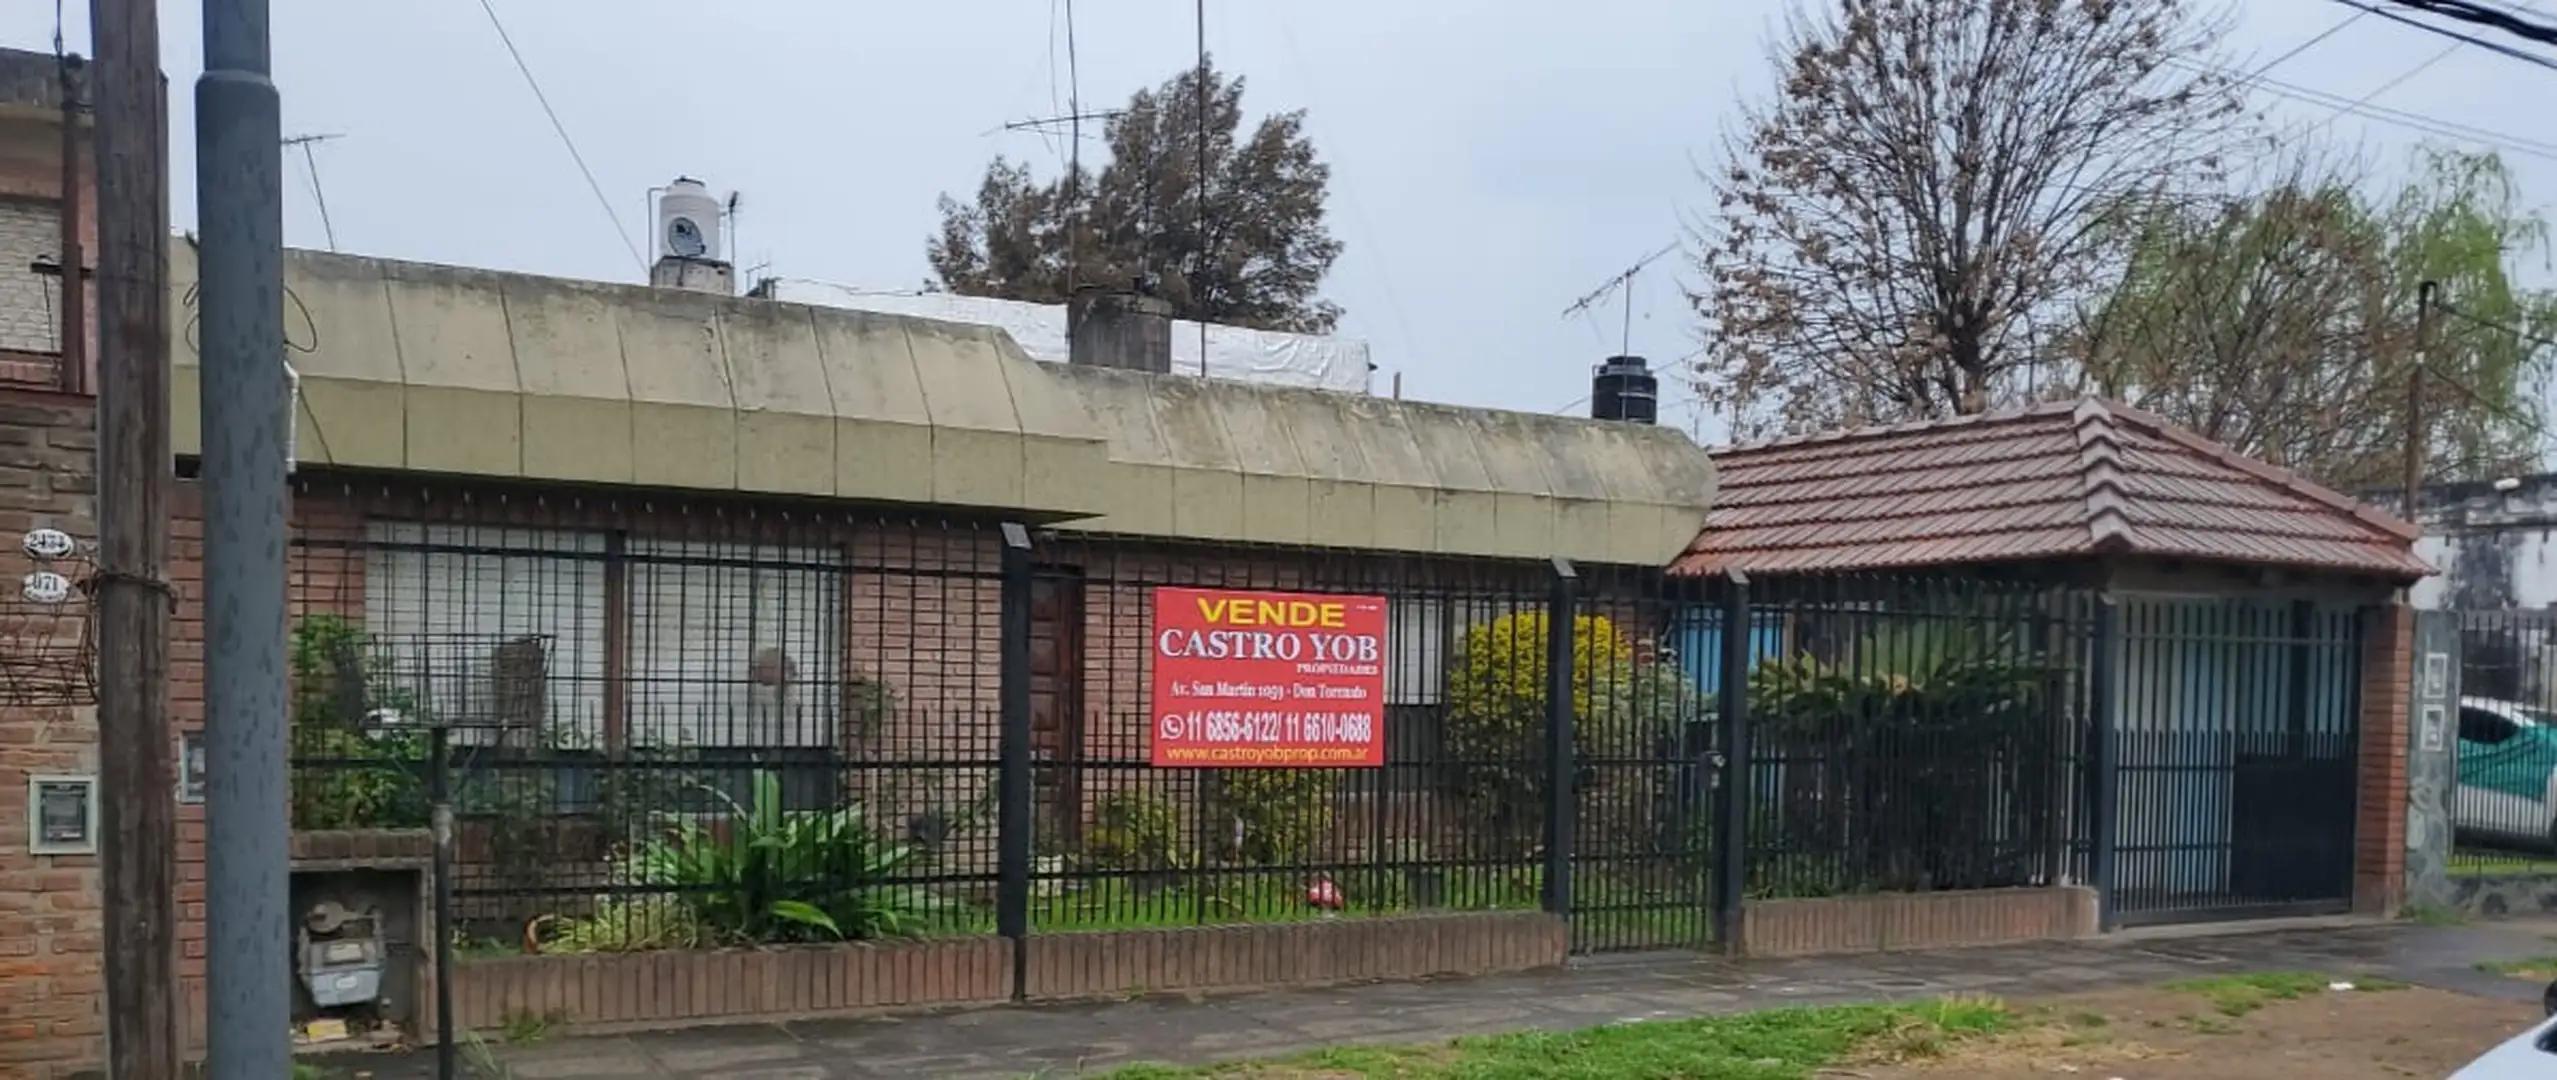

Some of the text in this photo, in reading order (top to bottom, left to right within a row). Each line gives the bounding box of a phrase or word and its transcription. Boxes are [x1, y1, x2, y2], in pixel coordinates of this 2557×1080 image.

[1197, 597, 1346, 628] VENDE
[1160, 628, 1378, 662] CASTRO YOB
[1297, 663, 1378, 676] PROPIEDADES
[1192, 680, 1214, 697] San
[1293, 682, 1316, 699] Don
[1186, 710, 1202, 742] 11
[1285, 711, 1299, 742] 11
[1166, 744, 1368, 764] www.castroyobprop.com.ar
